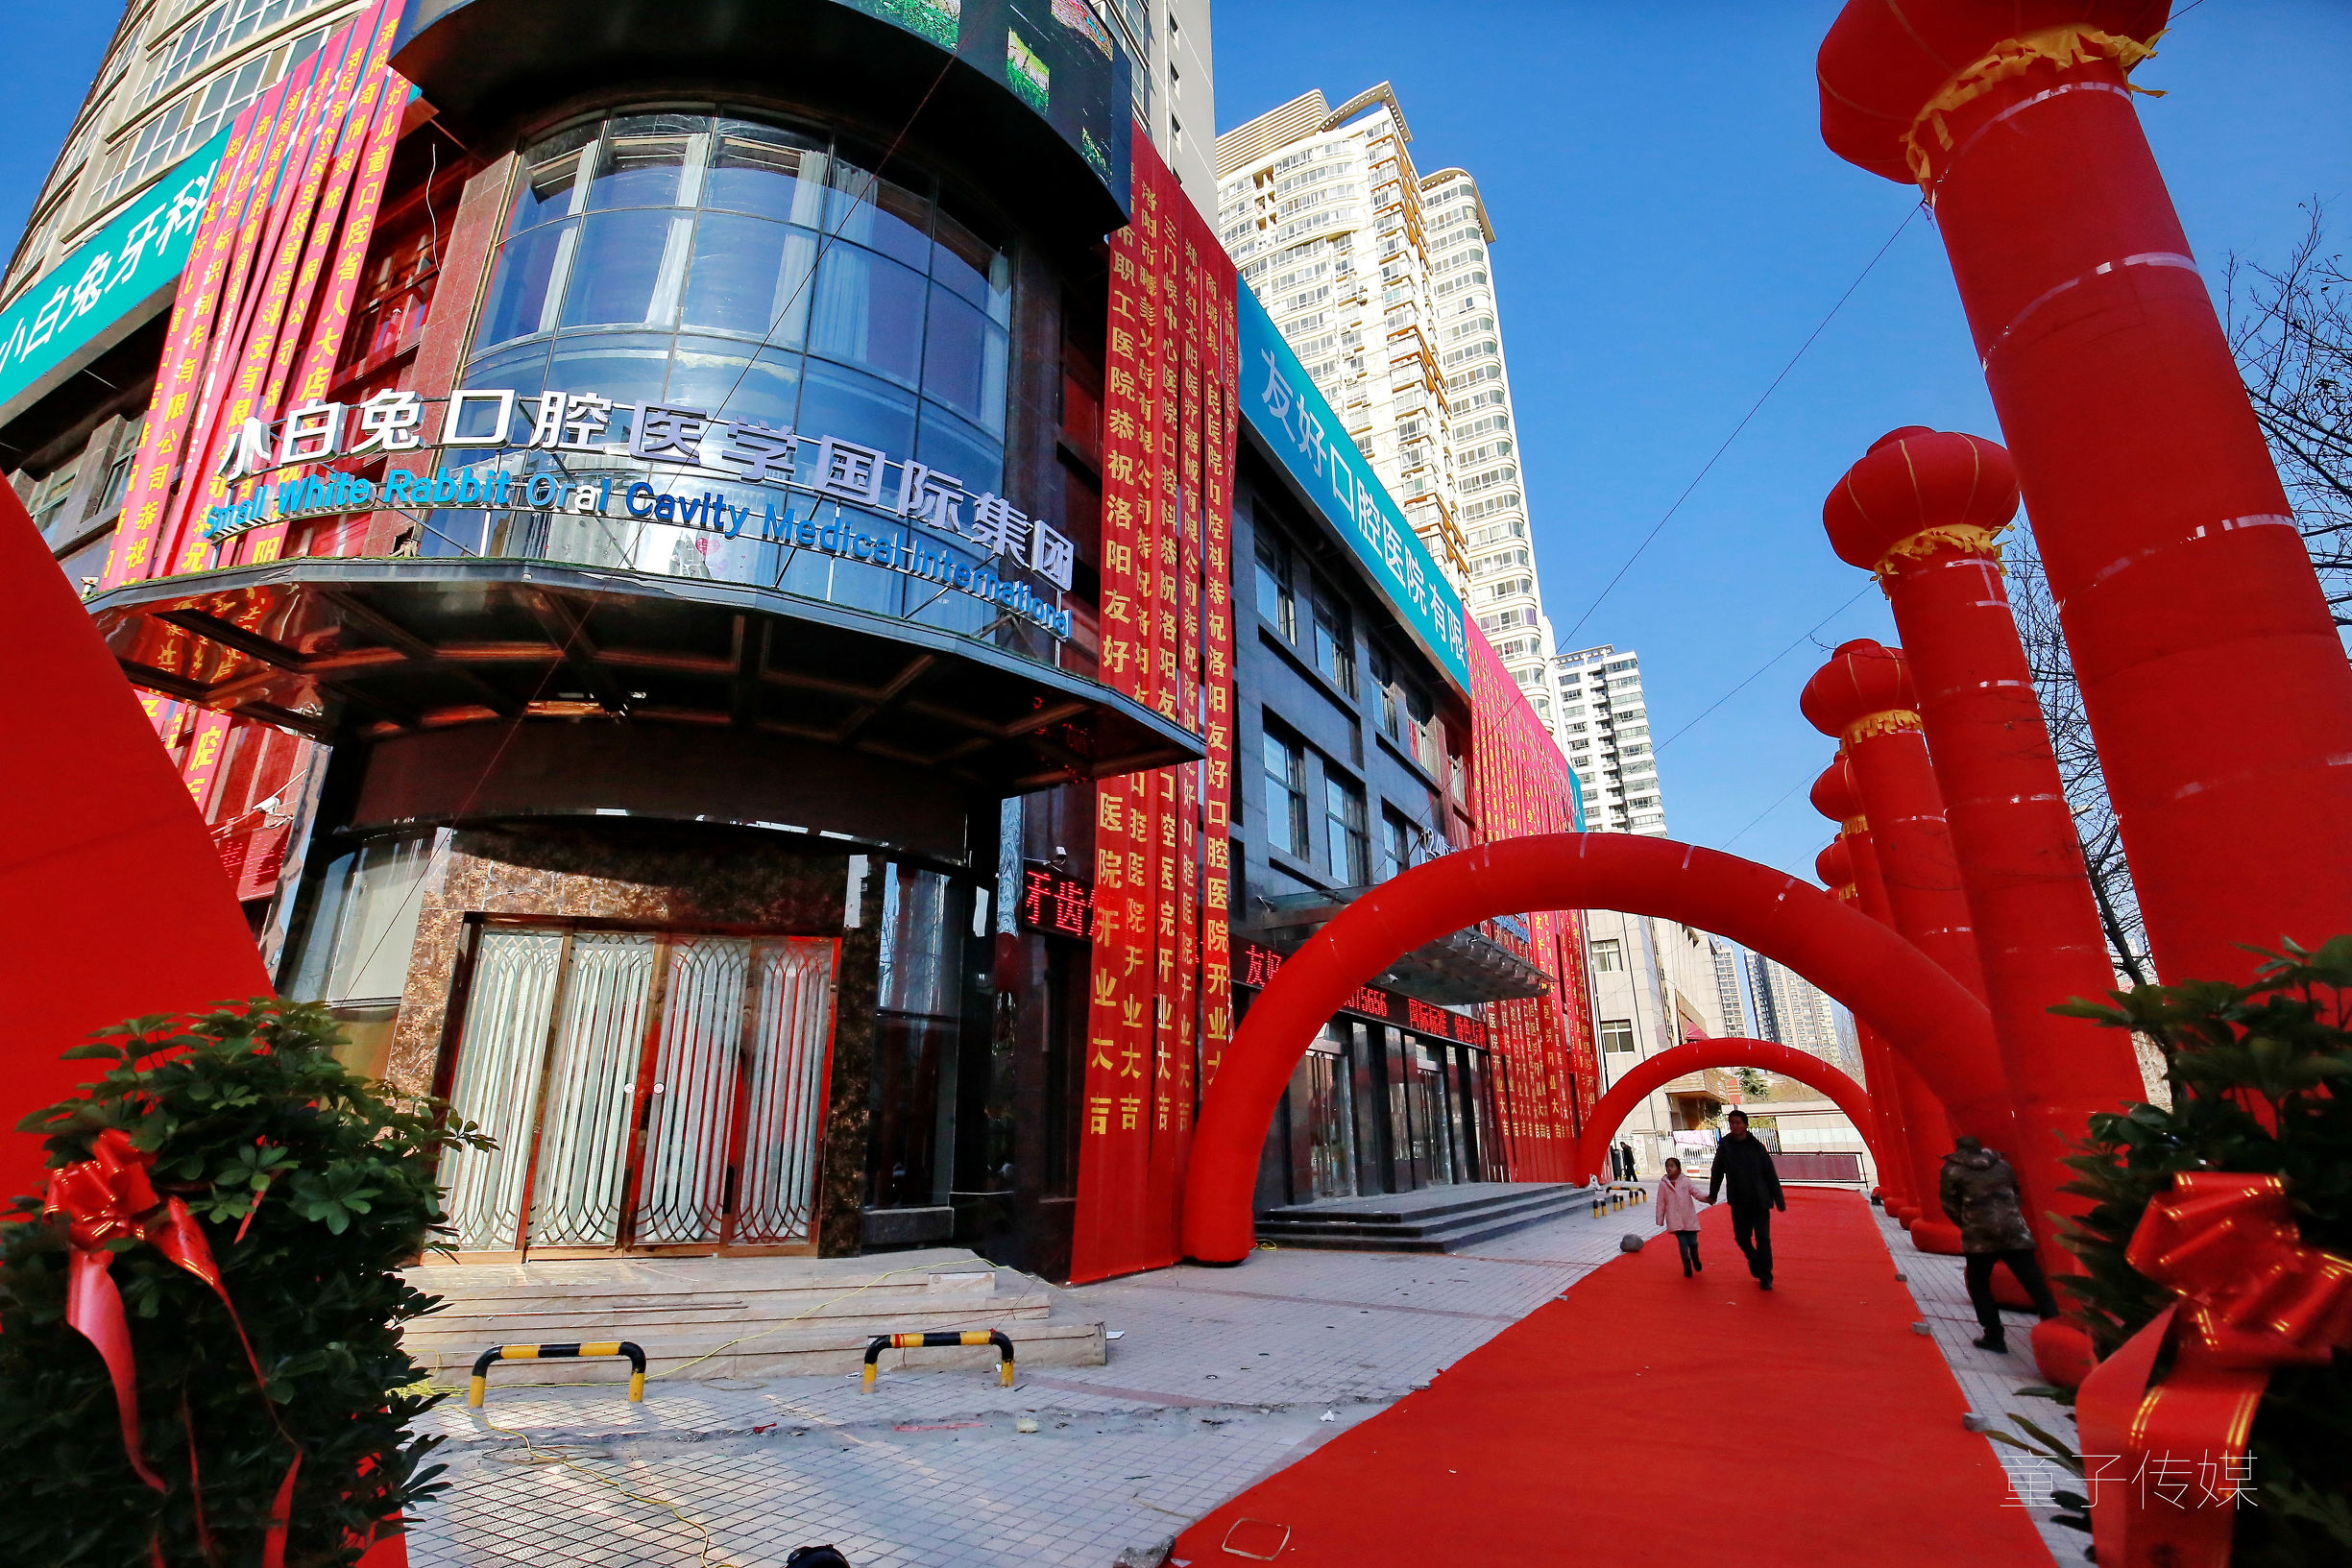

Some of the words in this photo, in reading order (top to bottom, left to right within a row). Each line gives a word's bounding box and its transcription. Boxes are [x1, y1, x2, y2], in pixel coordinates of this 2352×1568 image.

[0, 158, 218, 370] 小白兔牙科
[203, 484, 273, 539] Small
[279, 471, 372, 515] White
[383, 467, 513, 505] Rabbit
[526, 472, 610, 514] Oral
[626, 481, 749, 539] Cavity
[764, 502, 901, 567] Medical
[913, 538, 1073, 641] International
[218, 387, 1075, 592] 小白兔口腔医学国际集团
